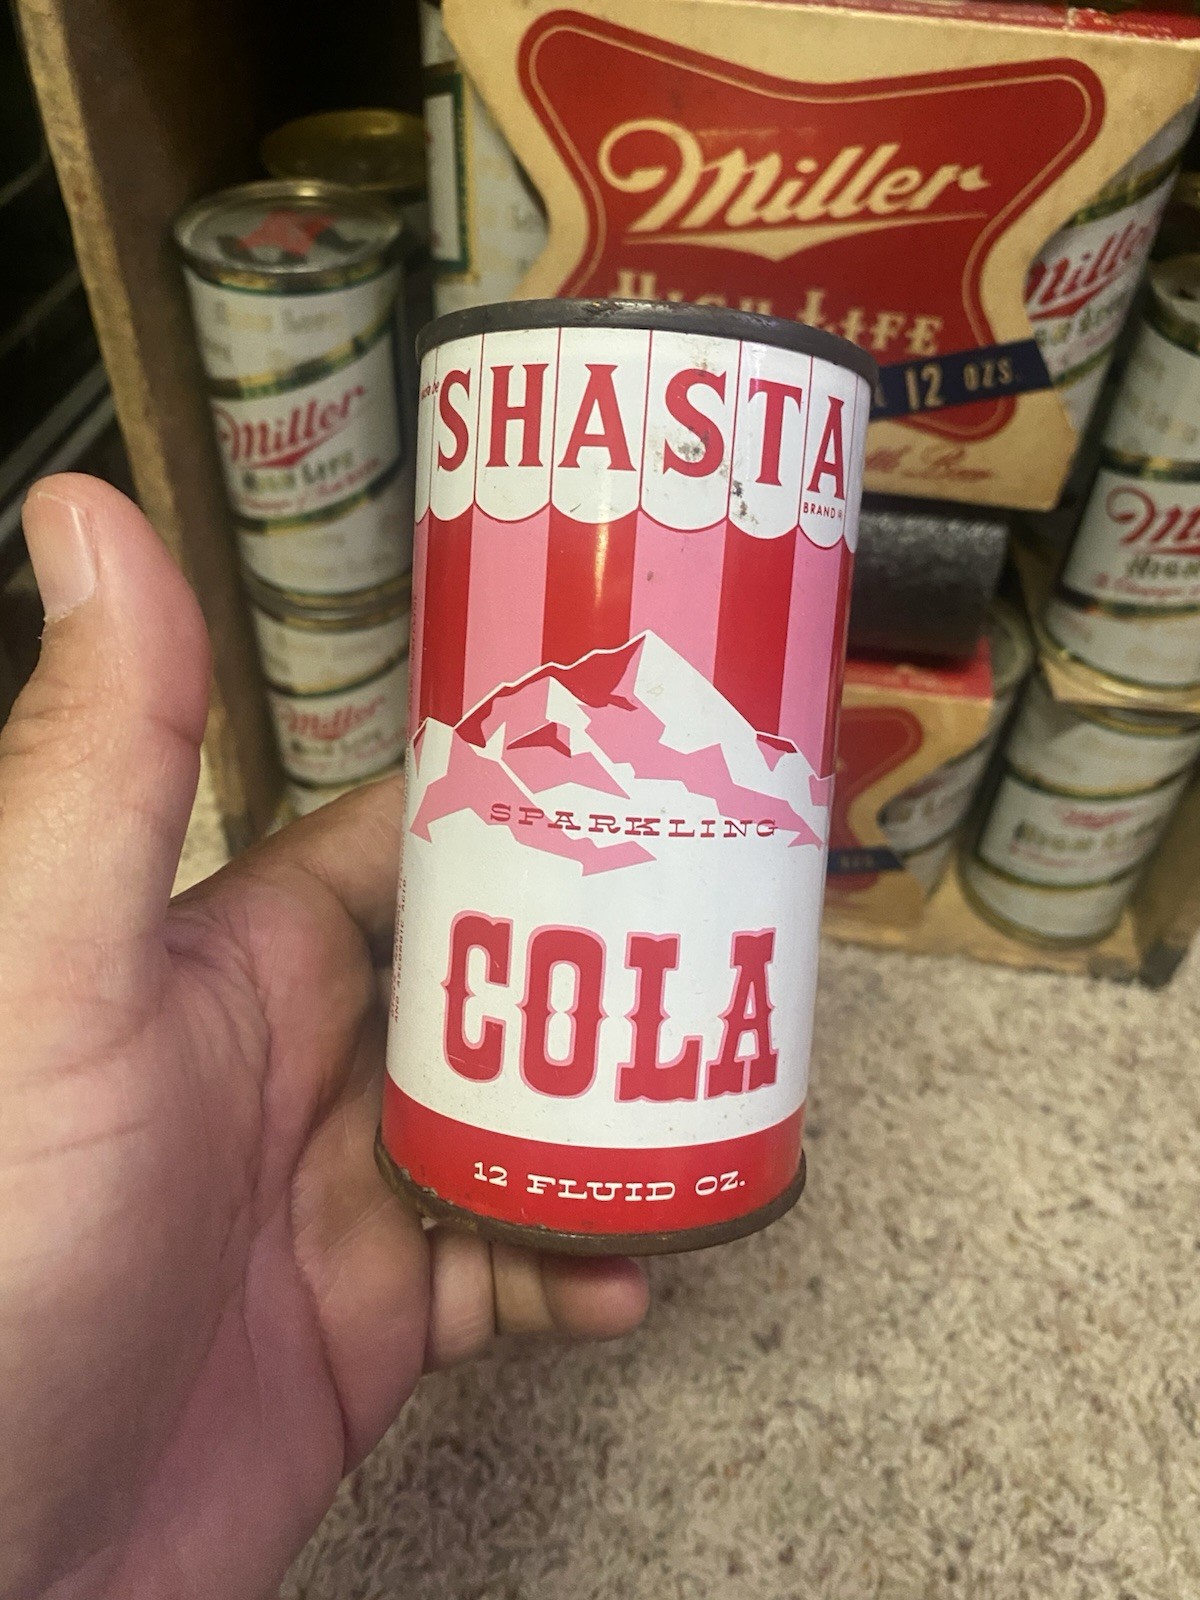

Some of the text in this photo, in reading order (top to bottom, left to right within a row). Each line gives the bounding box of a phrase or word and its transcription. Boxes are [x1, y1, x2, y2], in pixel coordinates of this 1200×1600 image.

[599, 119, 990, 234] Miller
[904, 362, 945, 411] 12
[437, 363, 846, 500] SHASTA
[803, 501, 836, 519] BRAND
[489, 803, 780, 838] SPARKLING
[441, 909, 780, 1103] COLA
[472, 1161, 747, 1202] 12 FLUID OZ.
